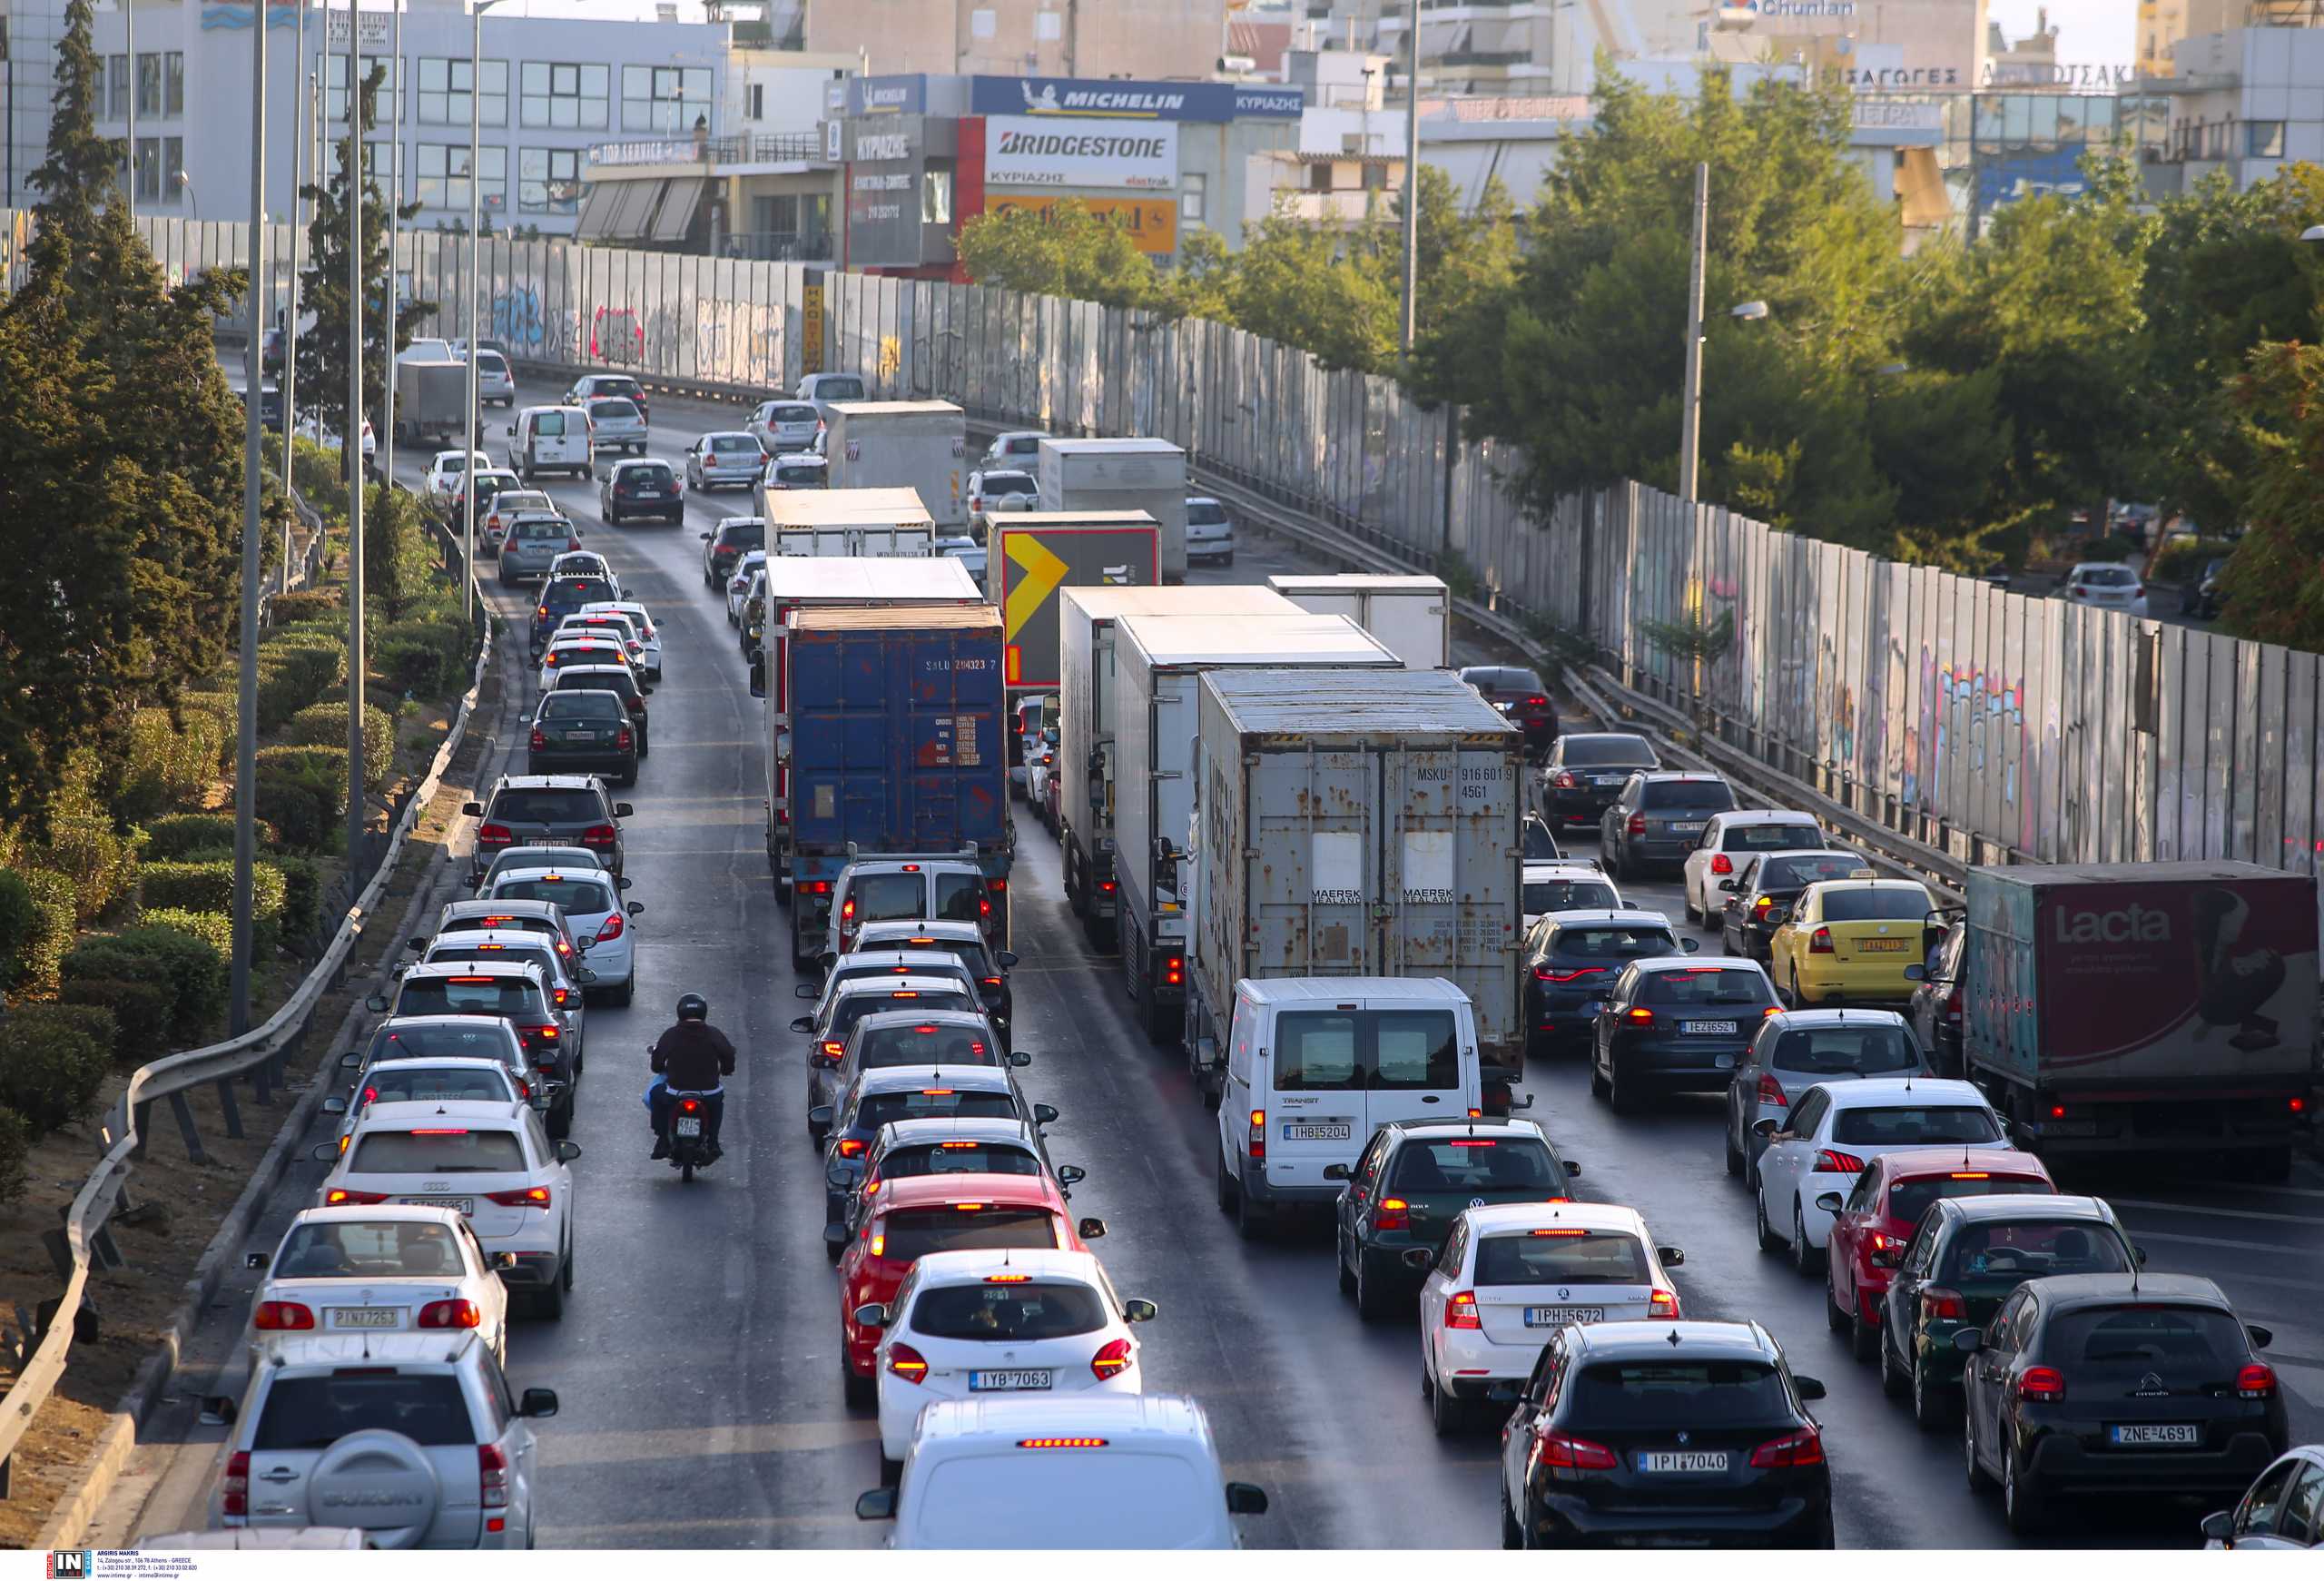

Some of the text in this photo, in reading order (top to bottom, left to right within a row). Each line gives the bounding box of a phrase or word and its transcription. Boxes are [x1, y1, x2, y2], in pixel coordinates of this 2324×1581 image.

[1764, 0, 1854, 15] Chunlan
[1063, 91, 1184, 110] MICHELIN
[1236, 95, 1301, 111] ΚΥΡΙΑΖΗΣ
[857, 135, 910, 161] ΚΥΡΙΑΖΗΣ
[998, 131, 1167, 159] BRIDGESTONE
[990, 172, 1066, 183] ΚΥΡΙΑΖΗΣ
[1417, 768, 1447, 781] MSKU
[1462, 786, 1487, 798] 45G1
[1311, 889, 1362, 898] MAERSK
[1403, 888, 1453, 897] MAERSK
[2055, 902, 2171, 944] Lacta
[323, 1489, 424, 1507] SUZUKI
